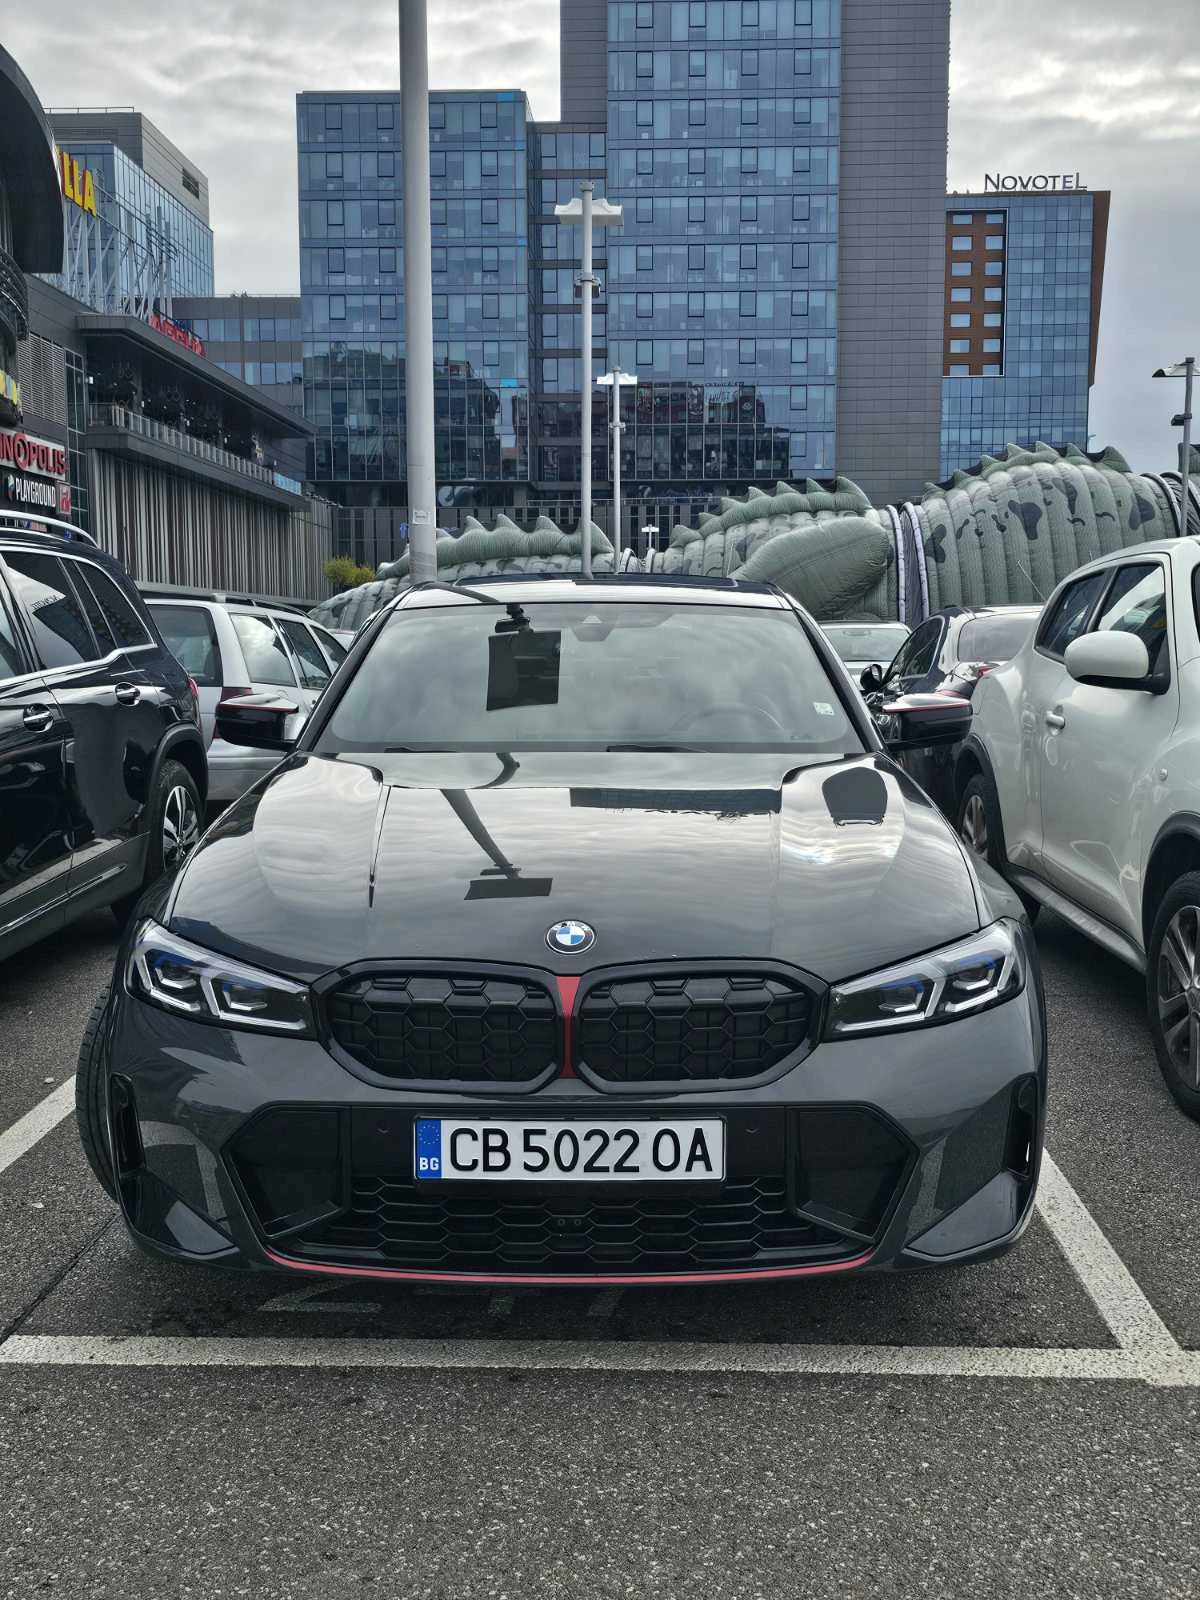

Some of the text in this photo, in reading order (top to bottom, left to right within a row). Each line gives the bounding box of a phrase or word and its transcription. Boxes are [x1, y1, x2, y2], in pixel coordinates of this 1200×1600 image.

[58, 150, 97, 217] LLA
[984, 172, 1087, 191] NOVOTEL
[15, 477, 57, 508] PLAYGROUND
[419, 1156, 440, 1171] BG
[449, 1127, 713, 1173] CB 5022 OA
